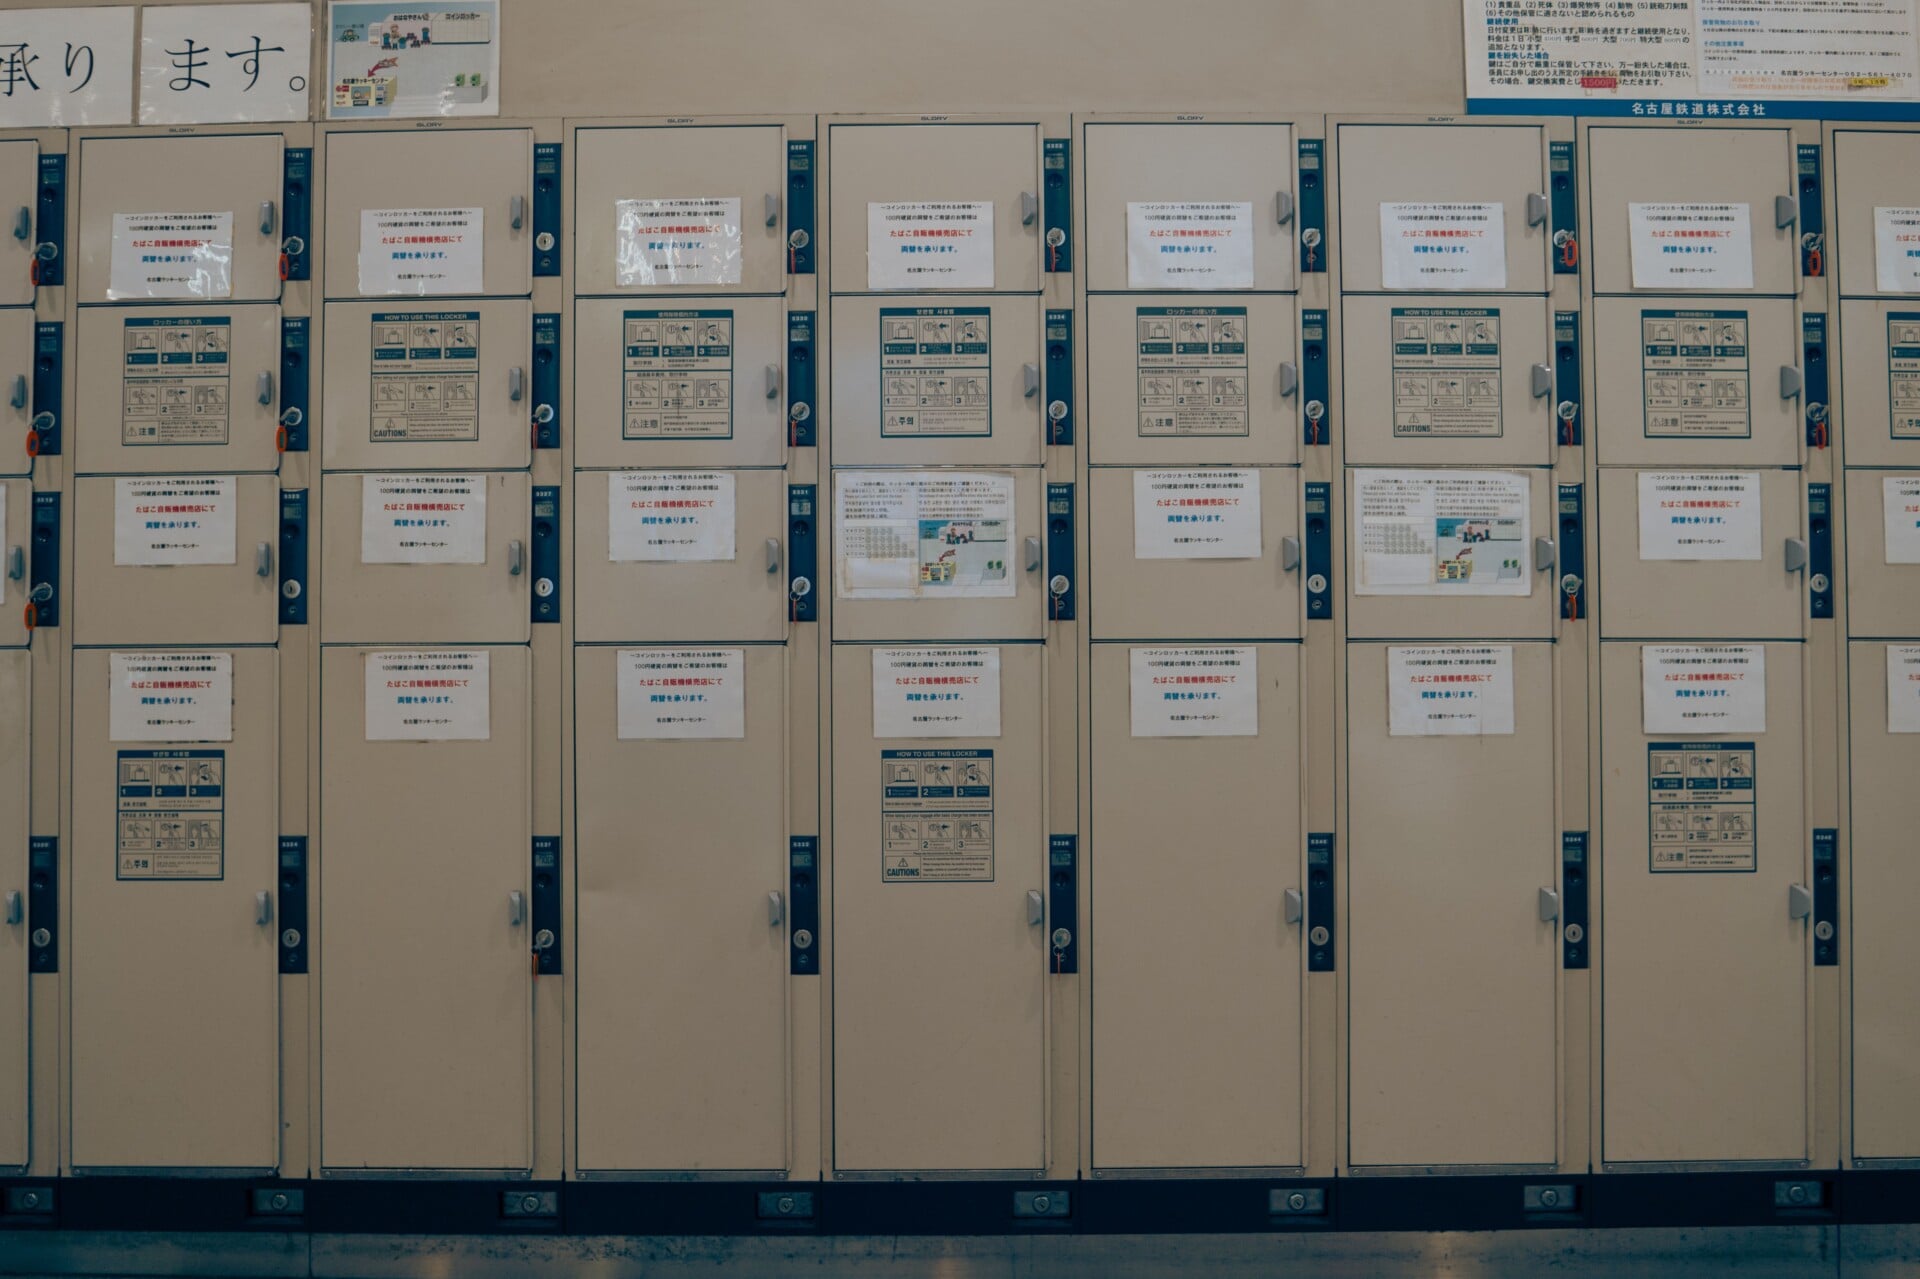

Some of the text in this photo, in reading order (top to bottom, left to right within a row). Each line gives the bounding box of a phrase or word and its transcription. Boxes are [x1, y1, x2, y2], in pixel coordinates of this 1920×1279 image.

[164, 35, 306, 92] ます。
[1631, 101, 1766, 116] 名古屋鉄道株式会社
[900, 245, 959, 254] 両替を承ります。
[391, 251, 448, 260] 両替を承ります。
[374, 429, 407, 437] CAUTIONS
[1397, 424, 1430, 433] CAUTIONS
[393, 518, 451, 527] 両替を承ります。
[641, 516, 700, 525] 両替を承ります。
[1167, 514, 1225, 523] 両替を承ります。
[145, 521, 201, 530] 両替を承ります。
[397, 695, 454, 704] 両替を承ります。
[649, 694, 708, 703] 両替を承ります。
[906, 692, 964, 702] 両替を承ります。
[1163, 692, 1222, 701] 両替を承ります。
[1421, 690, 1478, 700] 両替を承ります。
[140, 696, 197, 705] 両替を承ります。
[886, 868, 919, 877] CAUTIONS
